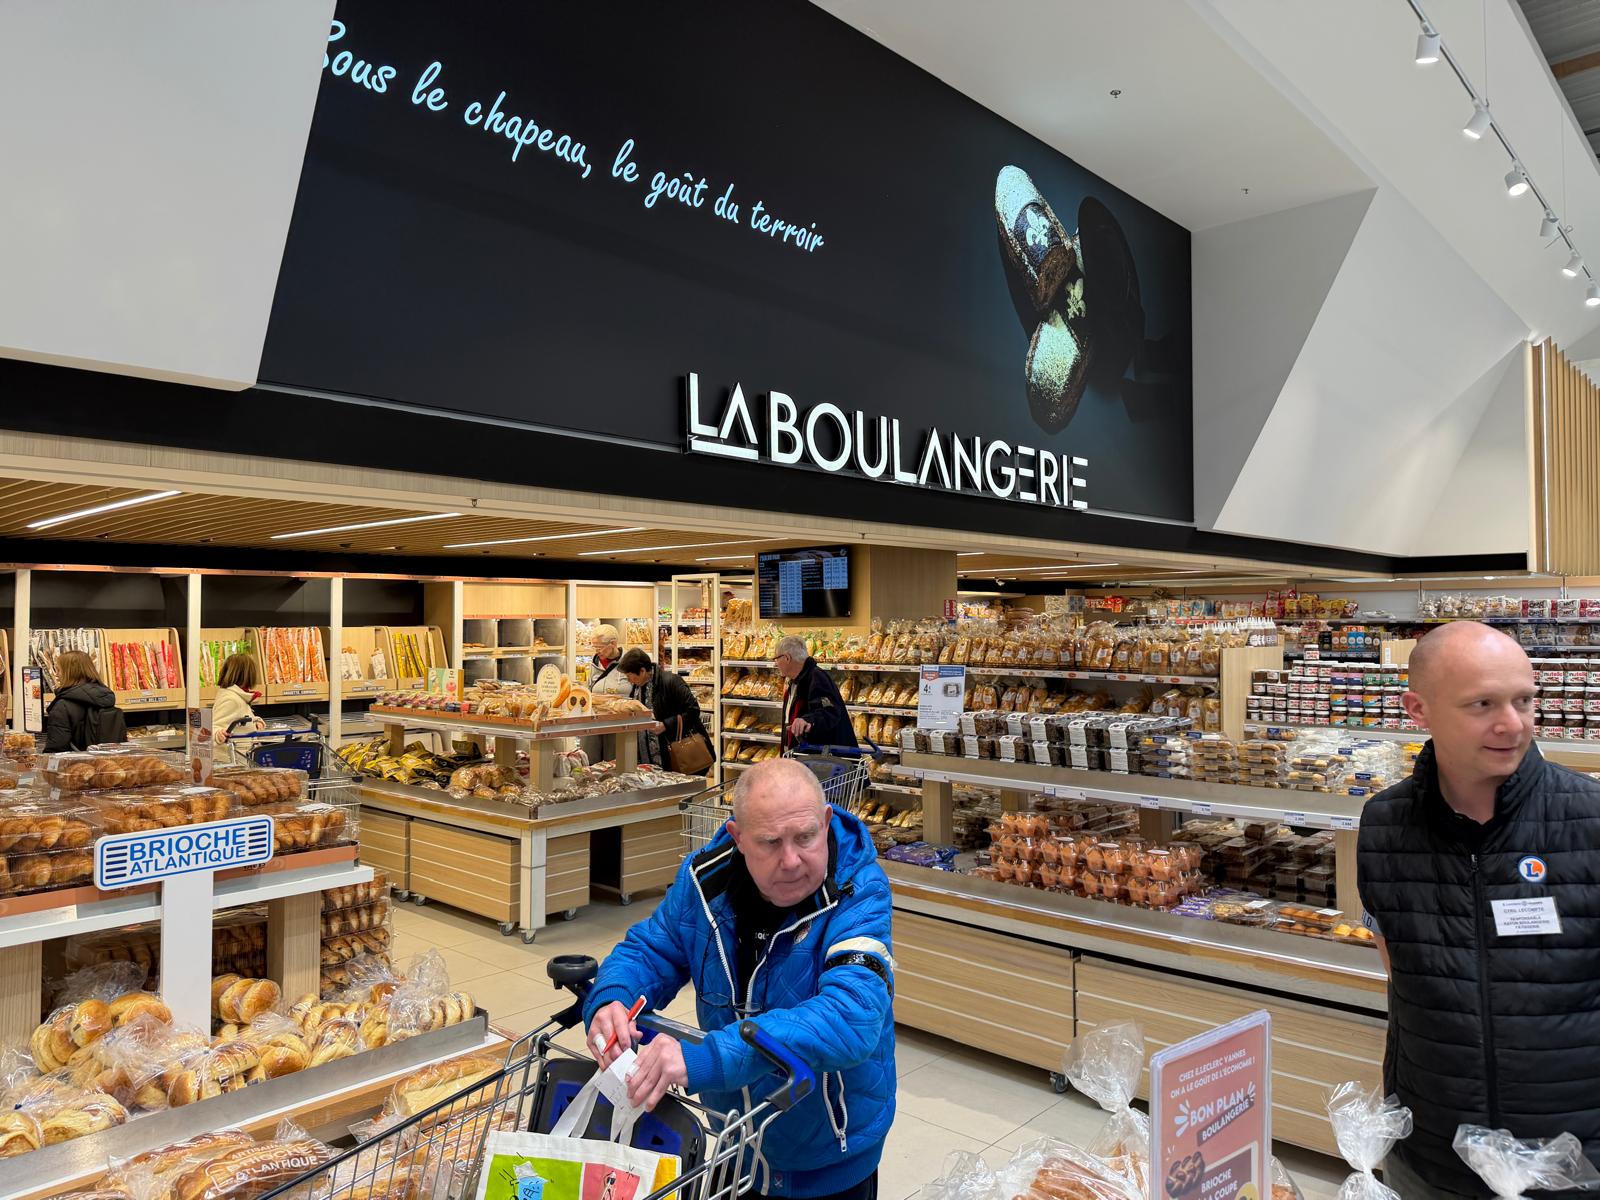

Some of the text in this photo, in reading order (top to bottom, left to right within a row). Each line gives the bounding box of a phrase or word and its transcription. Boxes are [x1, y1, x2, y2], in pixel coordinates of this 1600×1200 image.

[412, 62, 448, 111] le
[464, 91, 592, 178] chapeau,
[612, 139, 639, 182] le
[644, 172, 708, 208] goût
[714, 184, 739, 223] du
[751, 201, 824, 252] terroir
[690, 373, 1089, 511] LA BOULANGERIE
[129, 828, 246, 862] BRIOCHE
[130, 845, 246, 876] ATLANTIQUE
[1170, 1087, 1180, 1099] ON
[1181, 1086, 1186, 1094] A
[1186, 1082, 1194, 1092] LE
[1211, 1071, 1219, 1081] DE
[1179, 1069, 1195, 1082] CHEZ
[1190, 1087, 1245, 1127] BON PLAN
[1202, 1099, 1250, 1141] BOULANGERIE
[1201, 1168, 1232, 1193] BRIOCHE
[1214, 1180, 1238, 1200] COUPE
